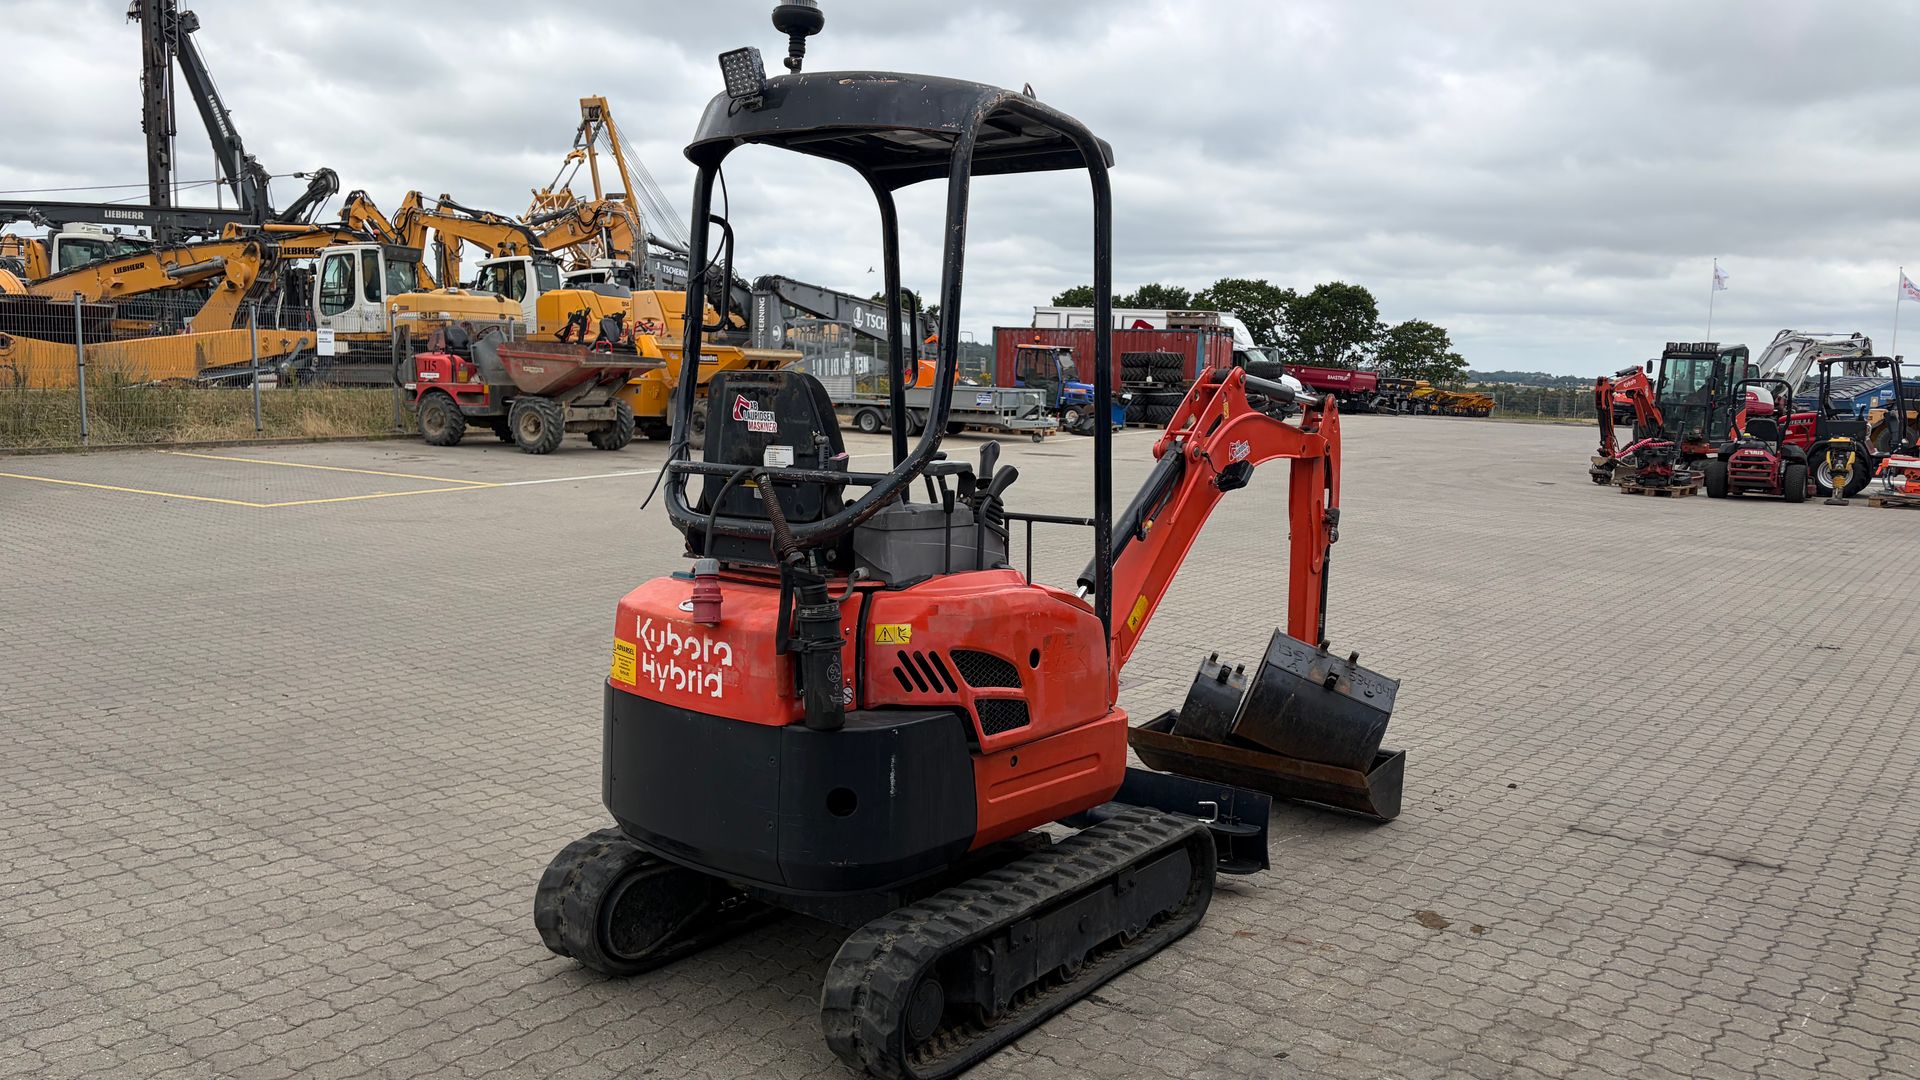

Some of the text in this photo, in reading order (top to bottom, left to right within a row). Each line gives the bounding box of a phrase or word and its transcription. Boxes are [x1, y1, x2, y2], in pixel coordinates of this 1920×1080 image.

[104, 210, 144, 220] LIEBHERR
[113, 262, 144, 274] LIEBHERR
[423, 360, 437, 371] 115
[749, 421, 777, 432] MASKINER
[636, 615, 732, 667] Kubota
[642, 651, 722, 698] Hybrid
